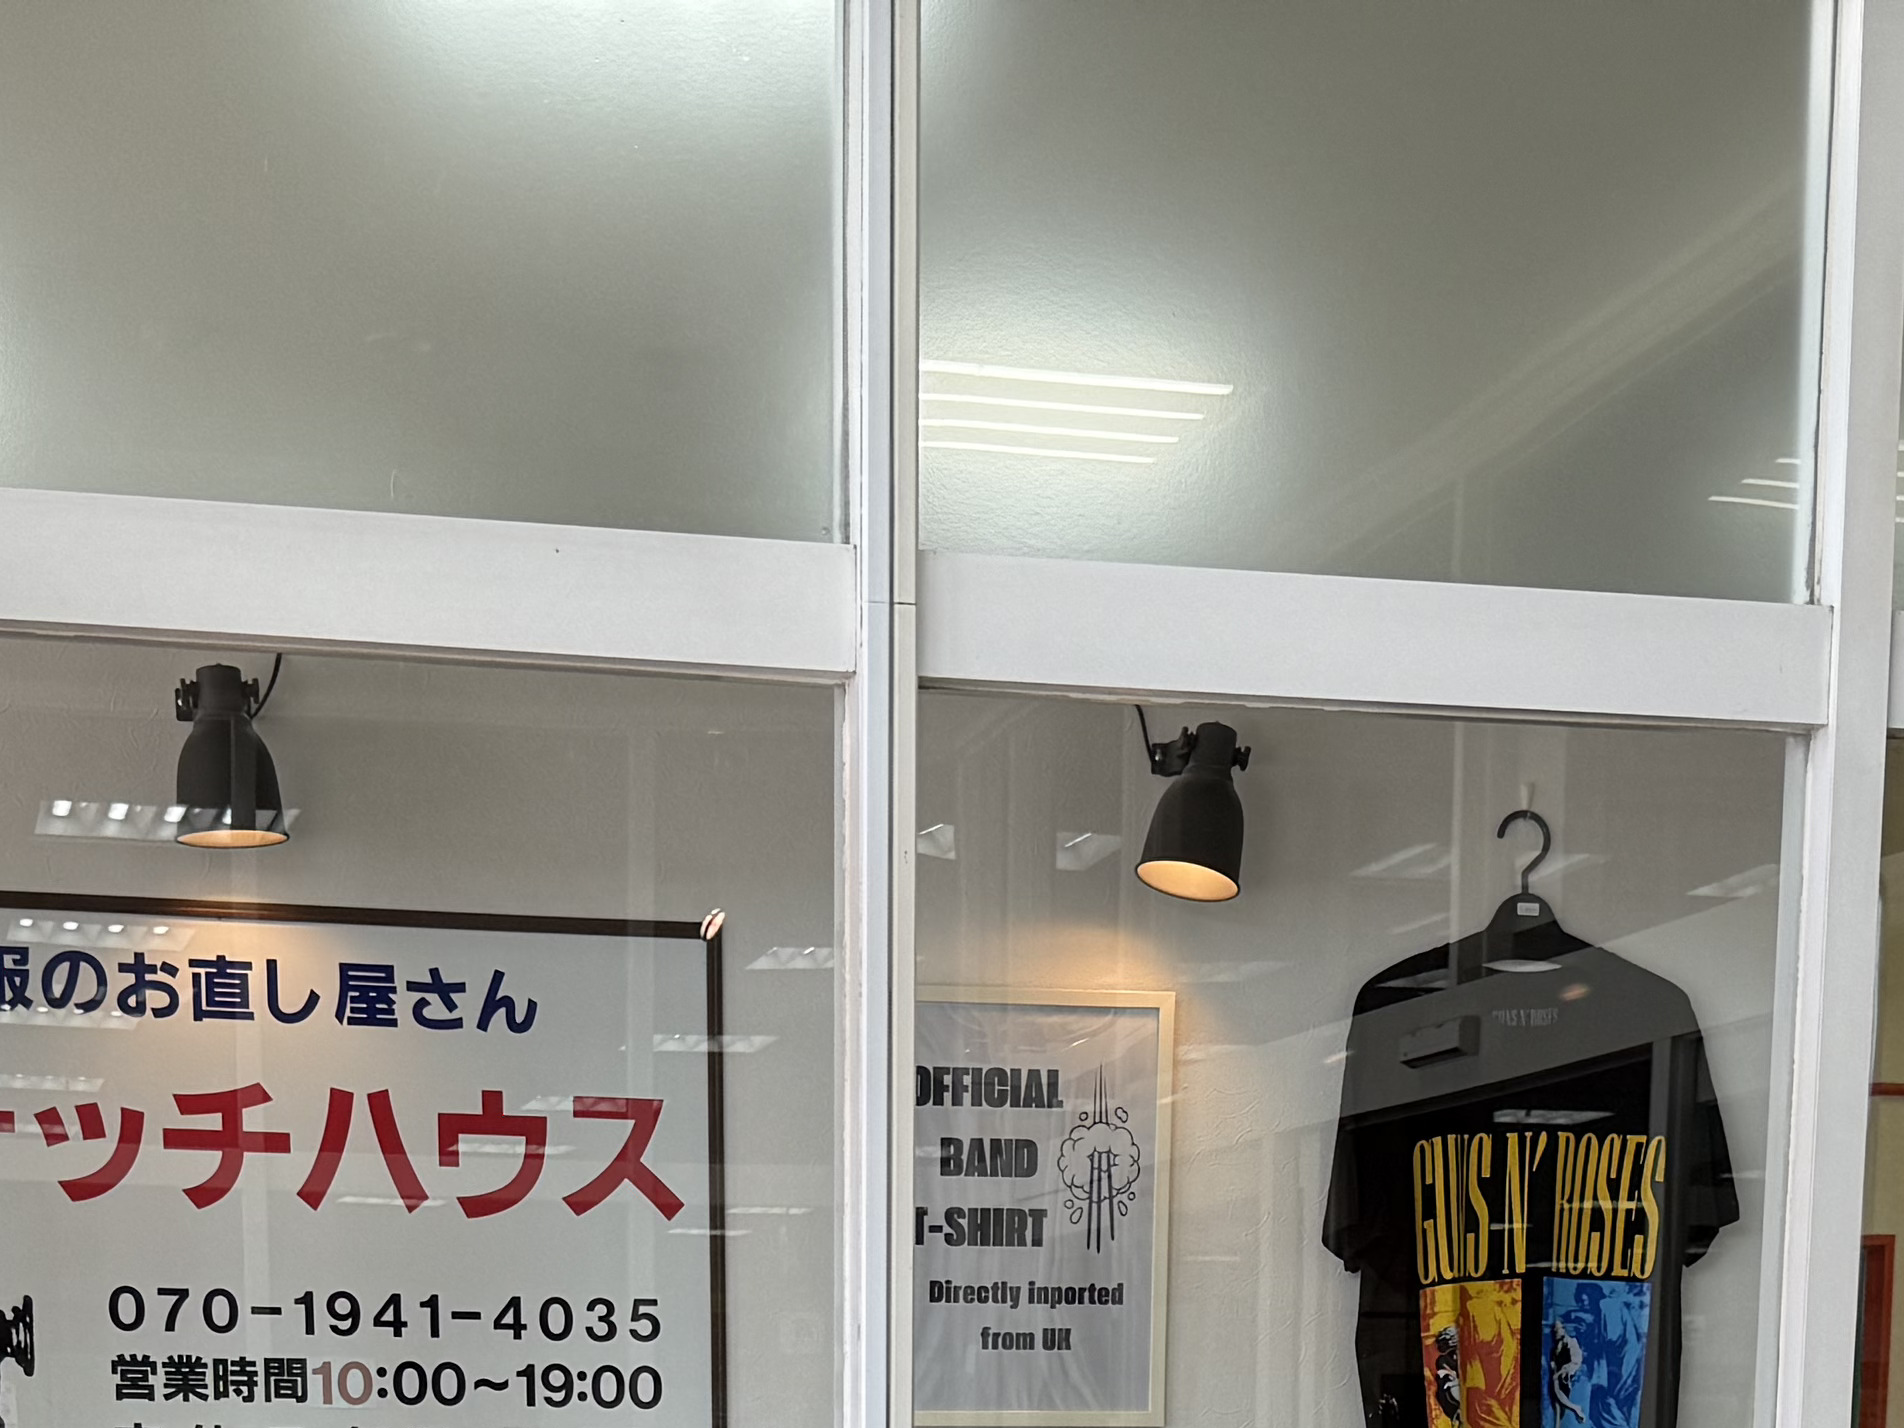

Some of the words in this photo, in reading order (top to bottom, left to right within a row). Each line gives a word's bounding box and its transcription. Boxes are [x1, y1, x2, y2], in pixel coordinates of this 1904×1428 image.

[940, 1136, 1039, 1179] BAND
[1412, 1132, 1493, 1286] GUNS
[1552, 1131, 1667, 1279] ROSES
[107, 1284, 663, 1345] 070-1941-4035
[929, 1279, 1022, 1309] Directly
[1027, 1280, 1125, 1308] inported
[980, 1325, 1036, 1351] from
[1042, 1326, 1072, 1351] UK
